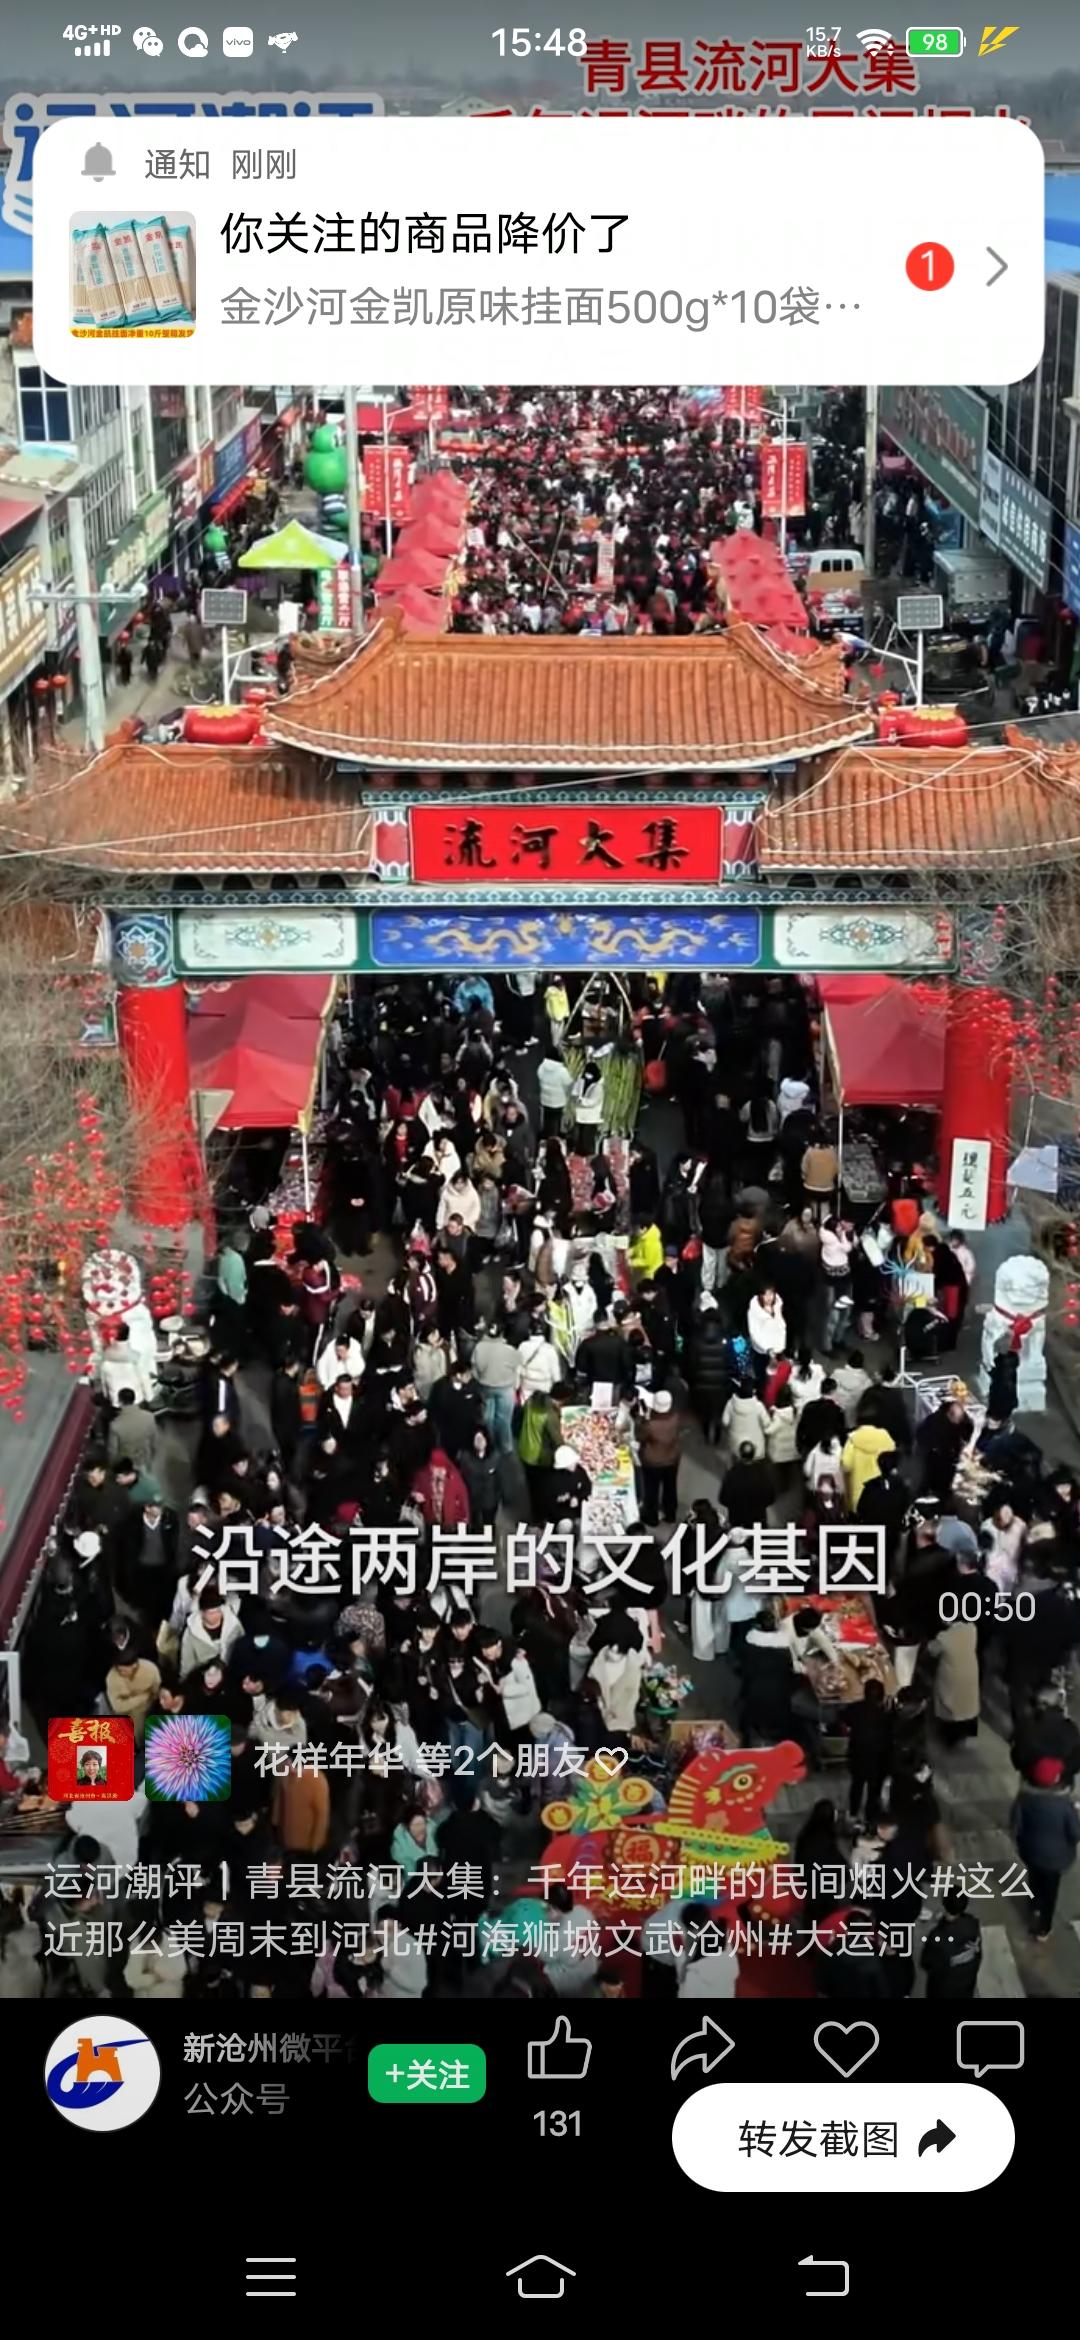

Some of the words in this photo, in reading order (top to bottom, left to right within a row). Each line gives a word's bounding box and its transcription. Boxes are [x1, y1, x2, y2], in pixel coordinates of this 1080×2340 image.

[225, 38, 252, 46] vivo
[492, 27, 589, 57] 15:48
[806, 26, 843, 42] 15.7
[921, 33, 950, 52] 98
[806, 44, 842, 58] KB/s
[144, 148, 211, 180] 通知
[232, 148, 297, 180] 刚刚
[220, 211, 630, 255] 你关注的商品降价了
[920, 249, 936, 282] 1
[445, 817, 689, 871] 流河大集
[938, 1591, 1037, 1623] 00:50
[253, 1741, 404, 1779] 花样年华
[416, 1741, 590, 1779] 等2个朋友
[182, 2031, 359, 2064] 新沧州微平
[385, 2058, 471, 2091] +关注
[184, 2081, 291, 2116] 公众号
[533, 2110, 582, 2138] 131
[738, 2119, 899, 2159] 转发截图
